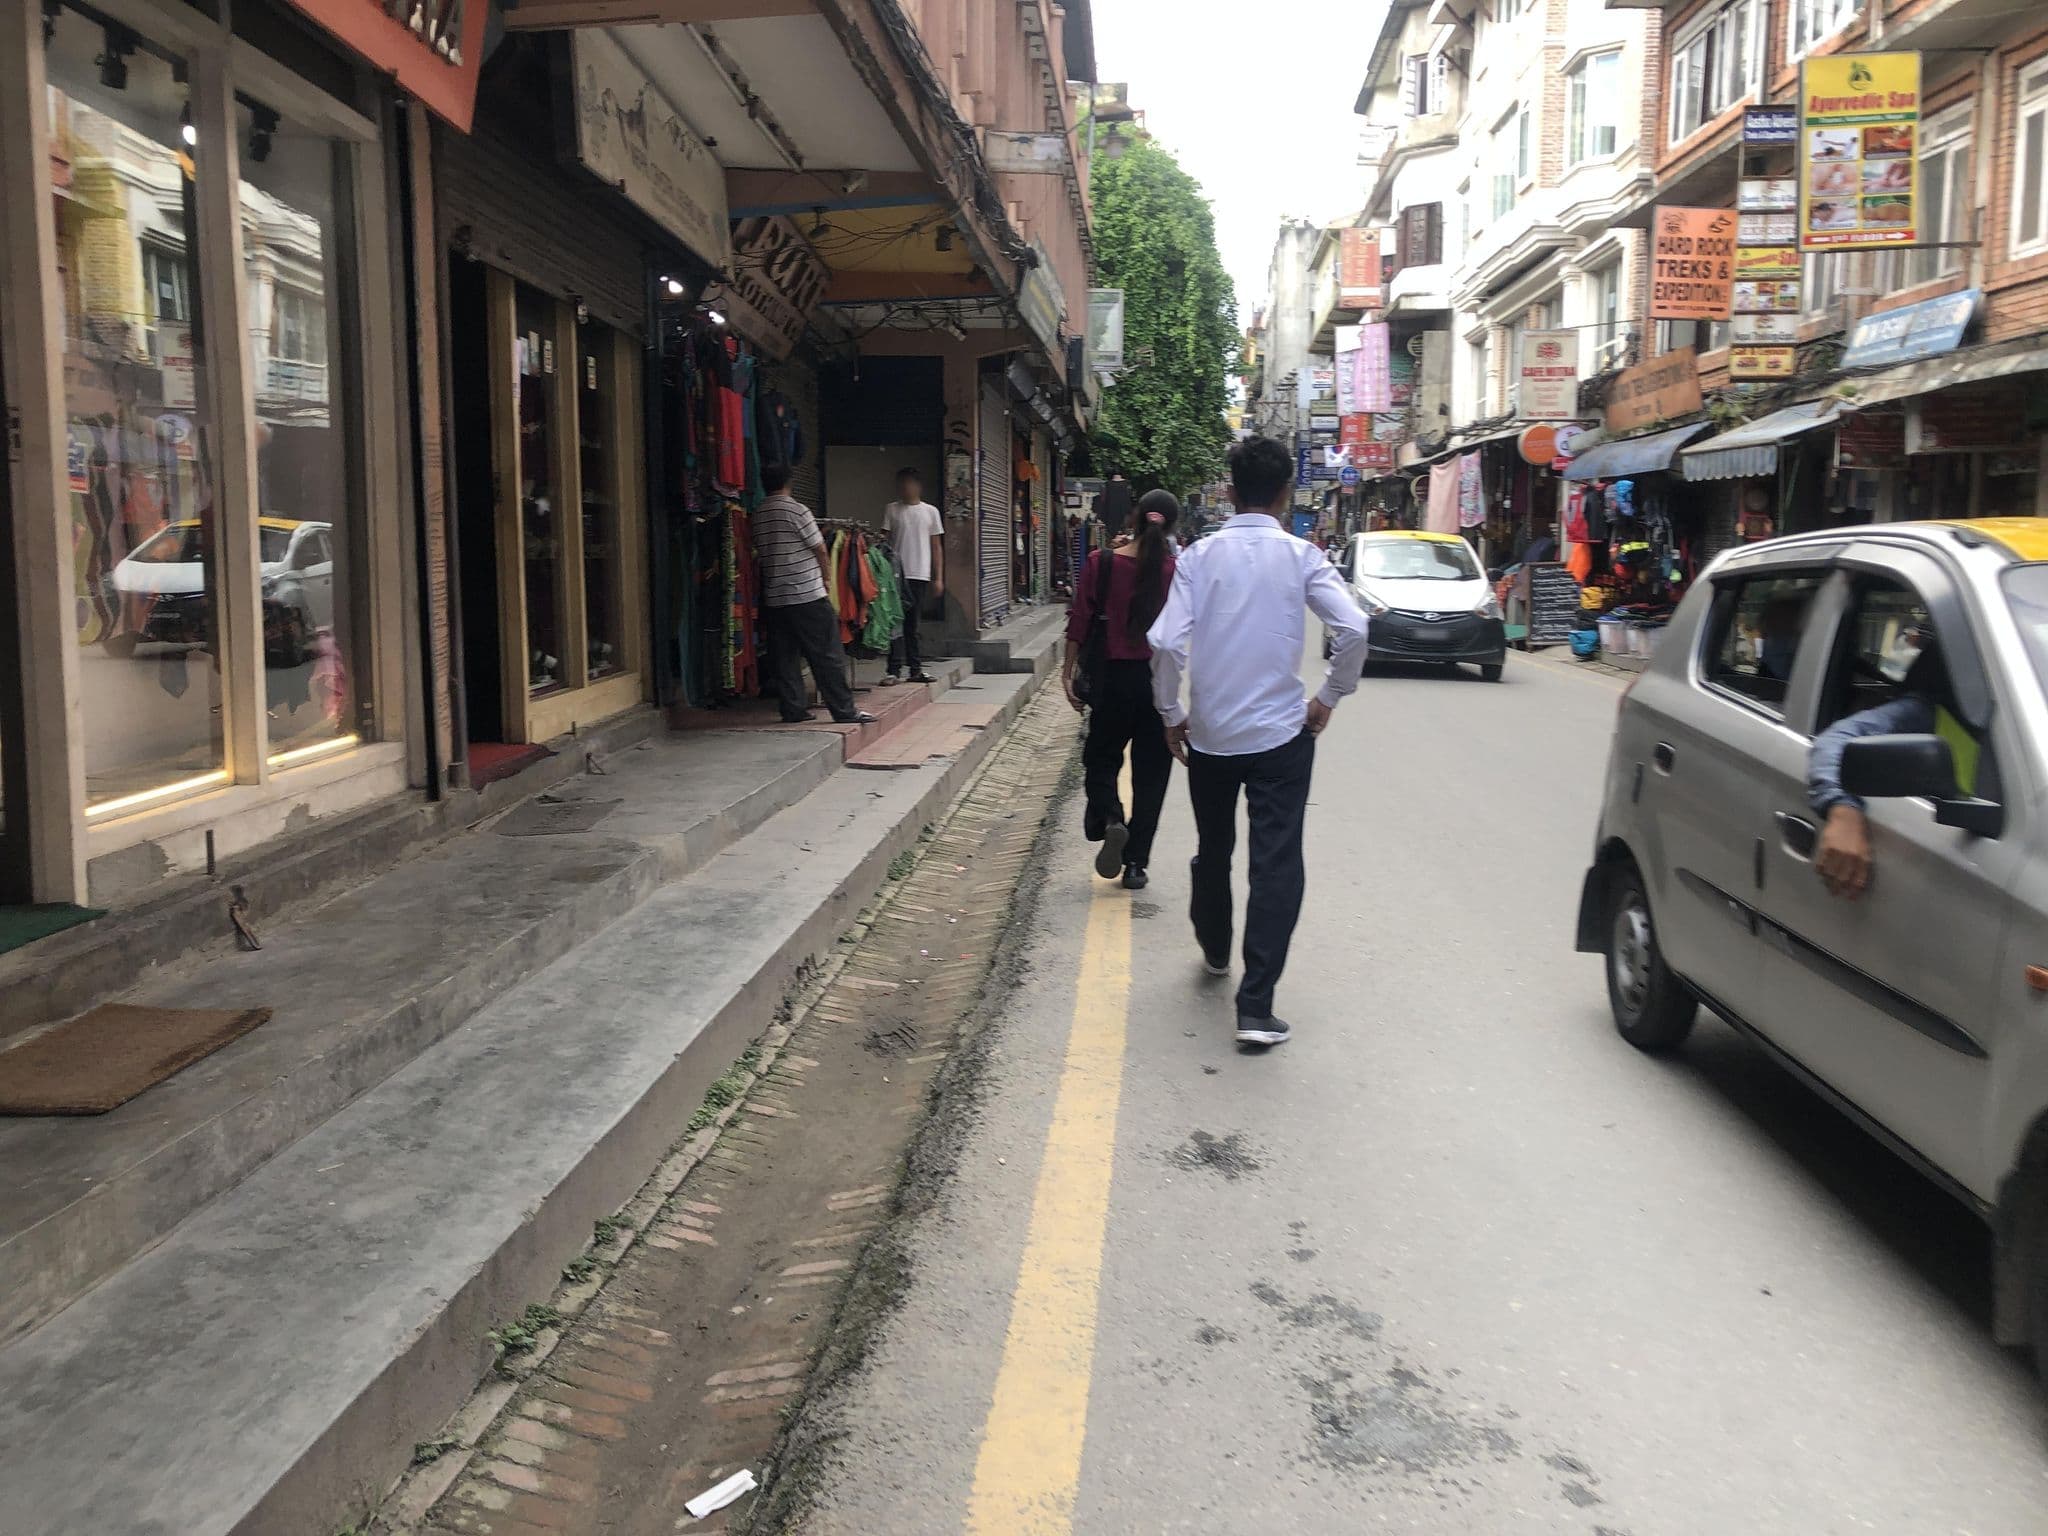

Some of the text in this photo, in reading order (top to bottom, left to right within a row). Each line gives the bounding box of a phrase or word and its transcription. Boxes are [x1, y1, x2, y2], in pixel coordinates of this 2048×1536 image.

[1809, 91, 1916, 114] Ayurvedic Spa
[1657, 236, 1732, 256] HARD ROCK
[1656, 259, 1729, 280] TREKS &
